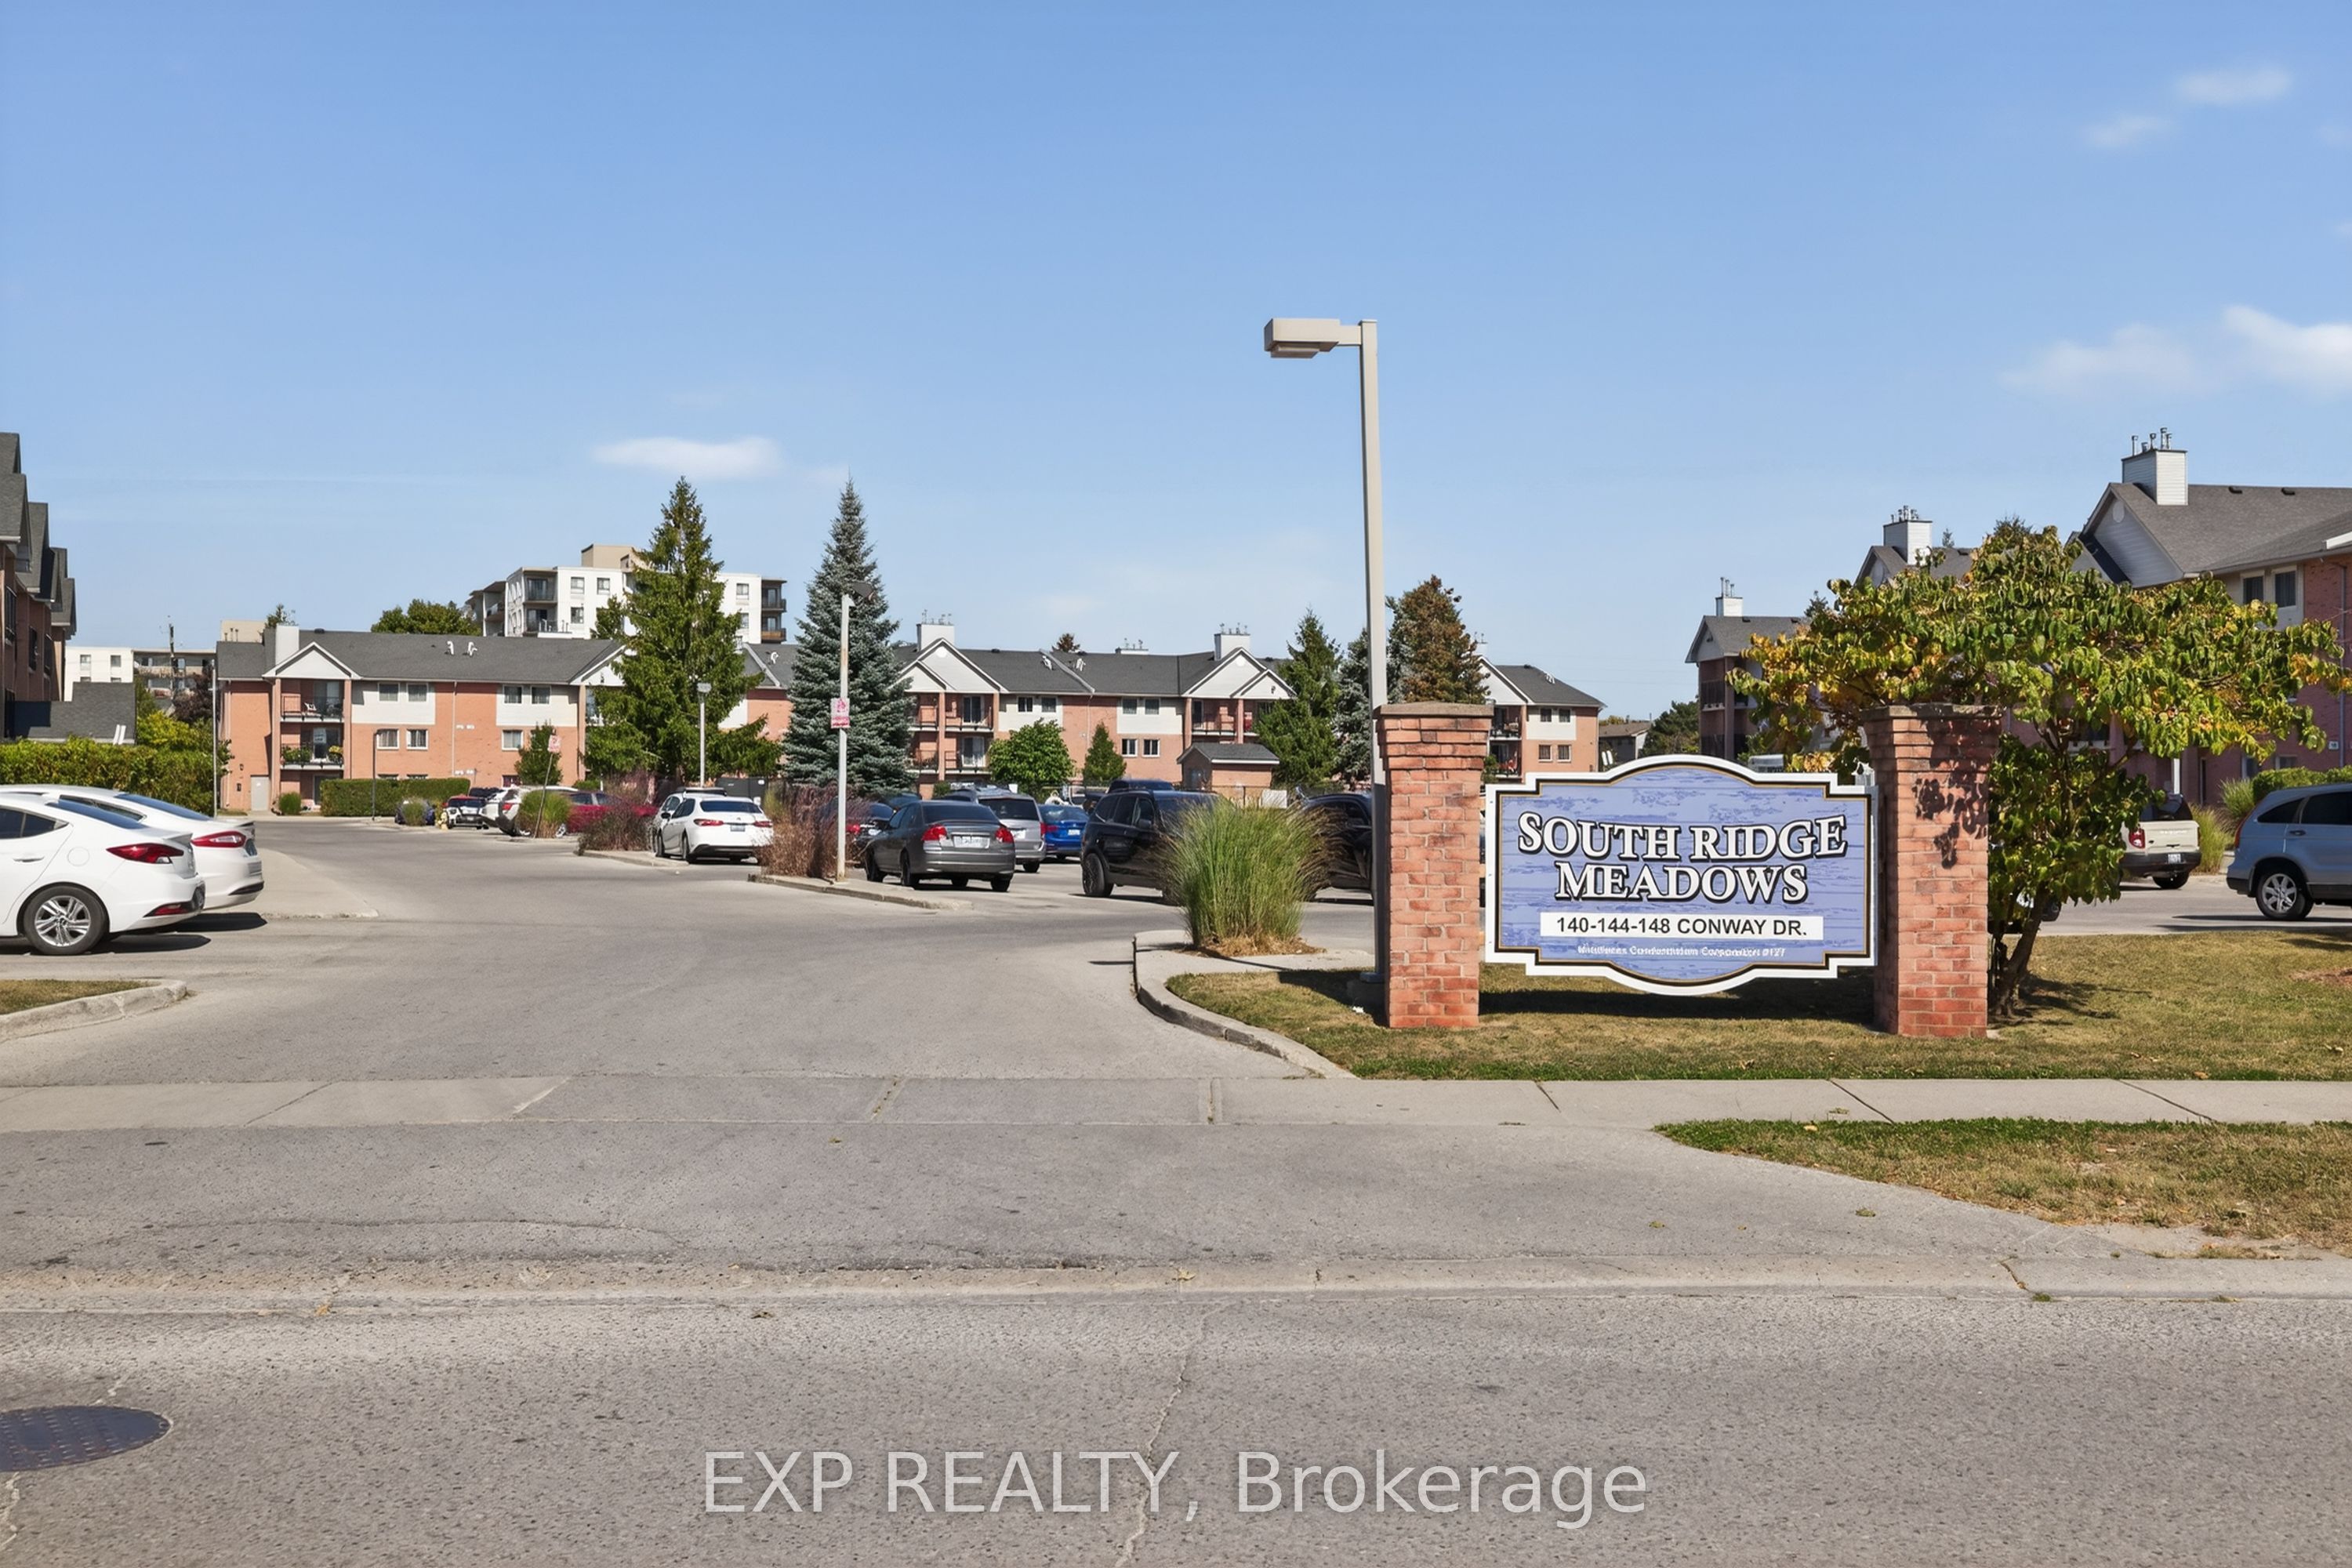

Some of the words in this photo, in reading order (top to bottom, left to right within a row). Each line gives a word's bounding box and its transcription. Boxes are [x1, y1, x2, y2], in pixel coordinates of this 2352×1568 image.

[1518, 811, 1681, 861] SOUTH
[1690, 815, 1847, 862] RIDGE
[1554, 861, 1808, 904] MEADOWS
[1557, 916, 1671, 934] 140-144-148
[1677, 918, 1766, 935] CONWAY
[1773, 920, 1807, 935] DR.
